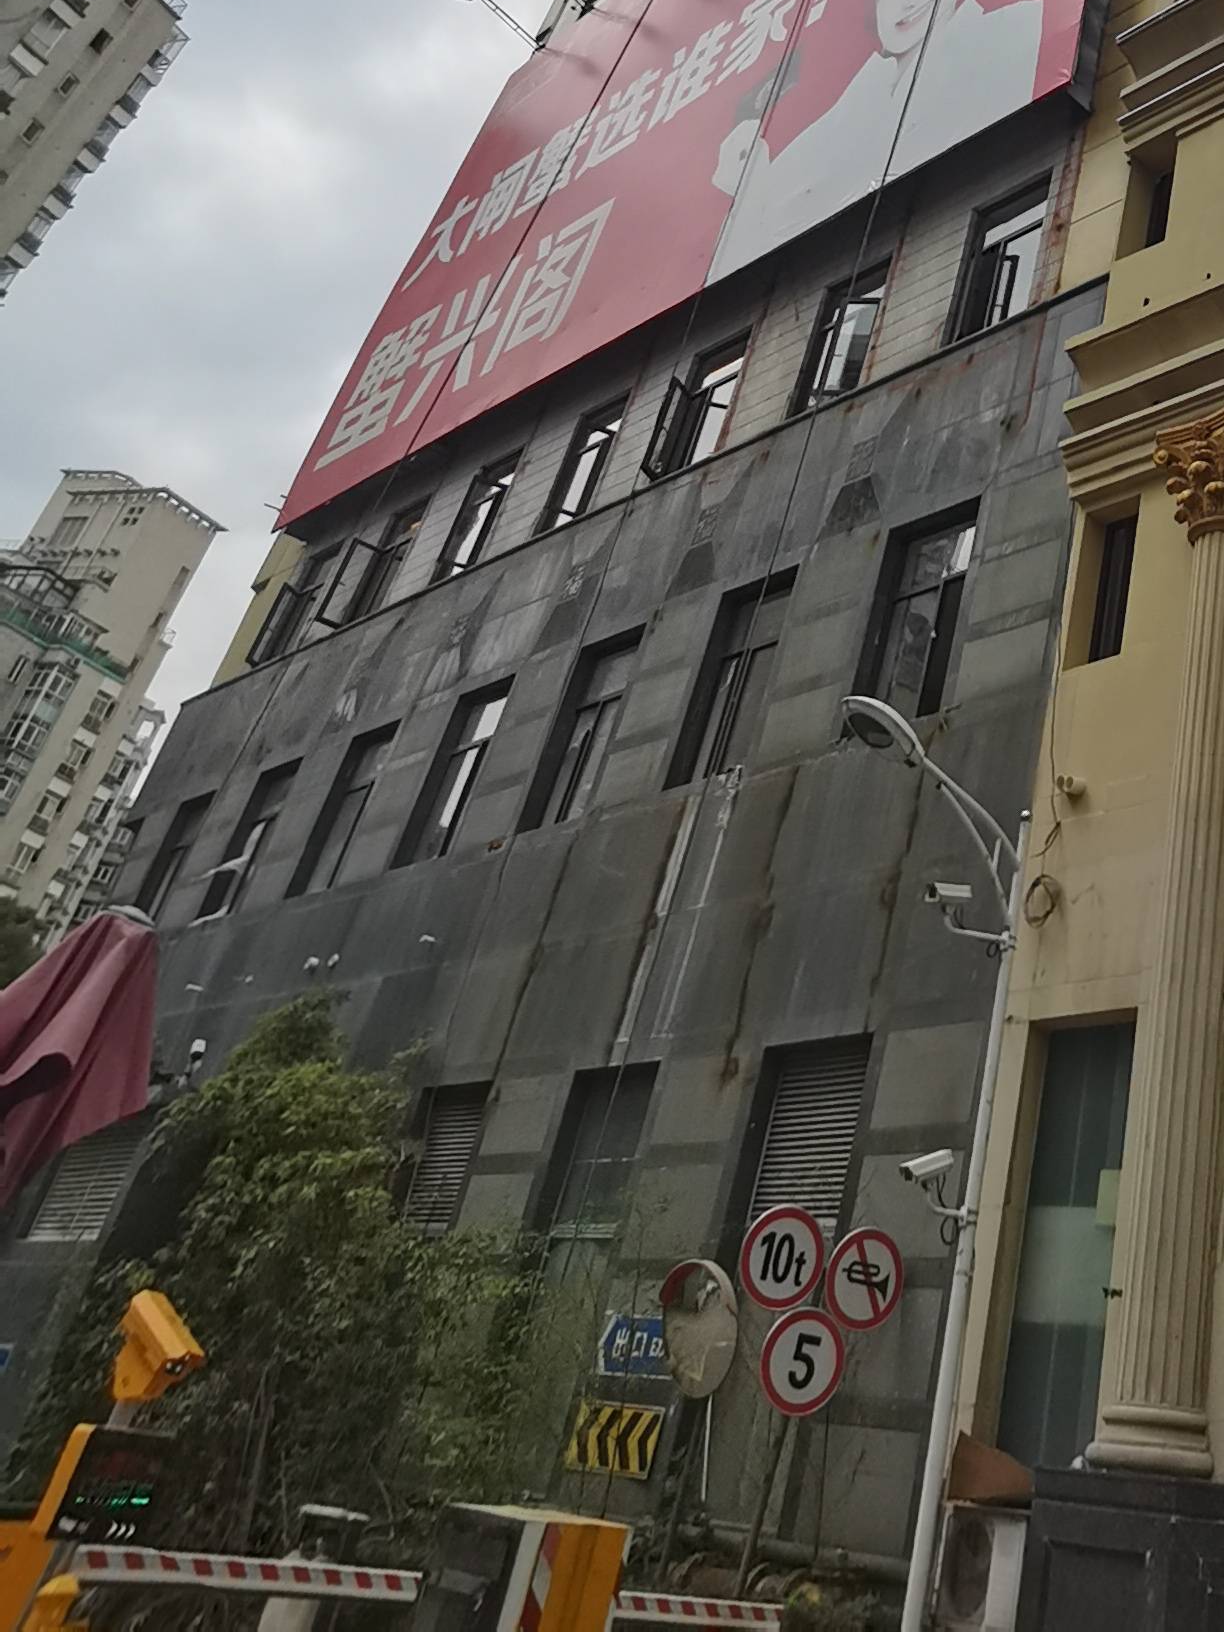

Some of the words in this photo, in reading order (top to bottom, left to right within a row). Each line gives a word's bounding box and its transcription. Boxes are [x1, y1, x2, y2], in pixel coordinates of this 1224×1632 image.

[313, 197, 617, 473] 蟹兴阁
[760, 1231, 807, 1287] 10t
[788, 1332, 822, 1390] 5
